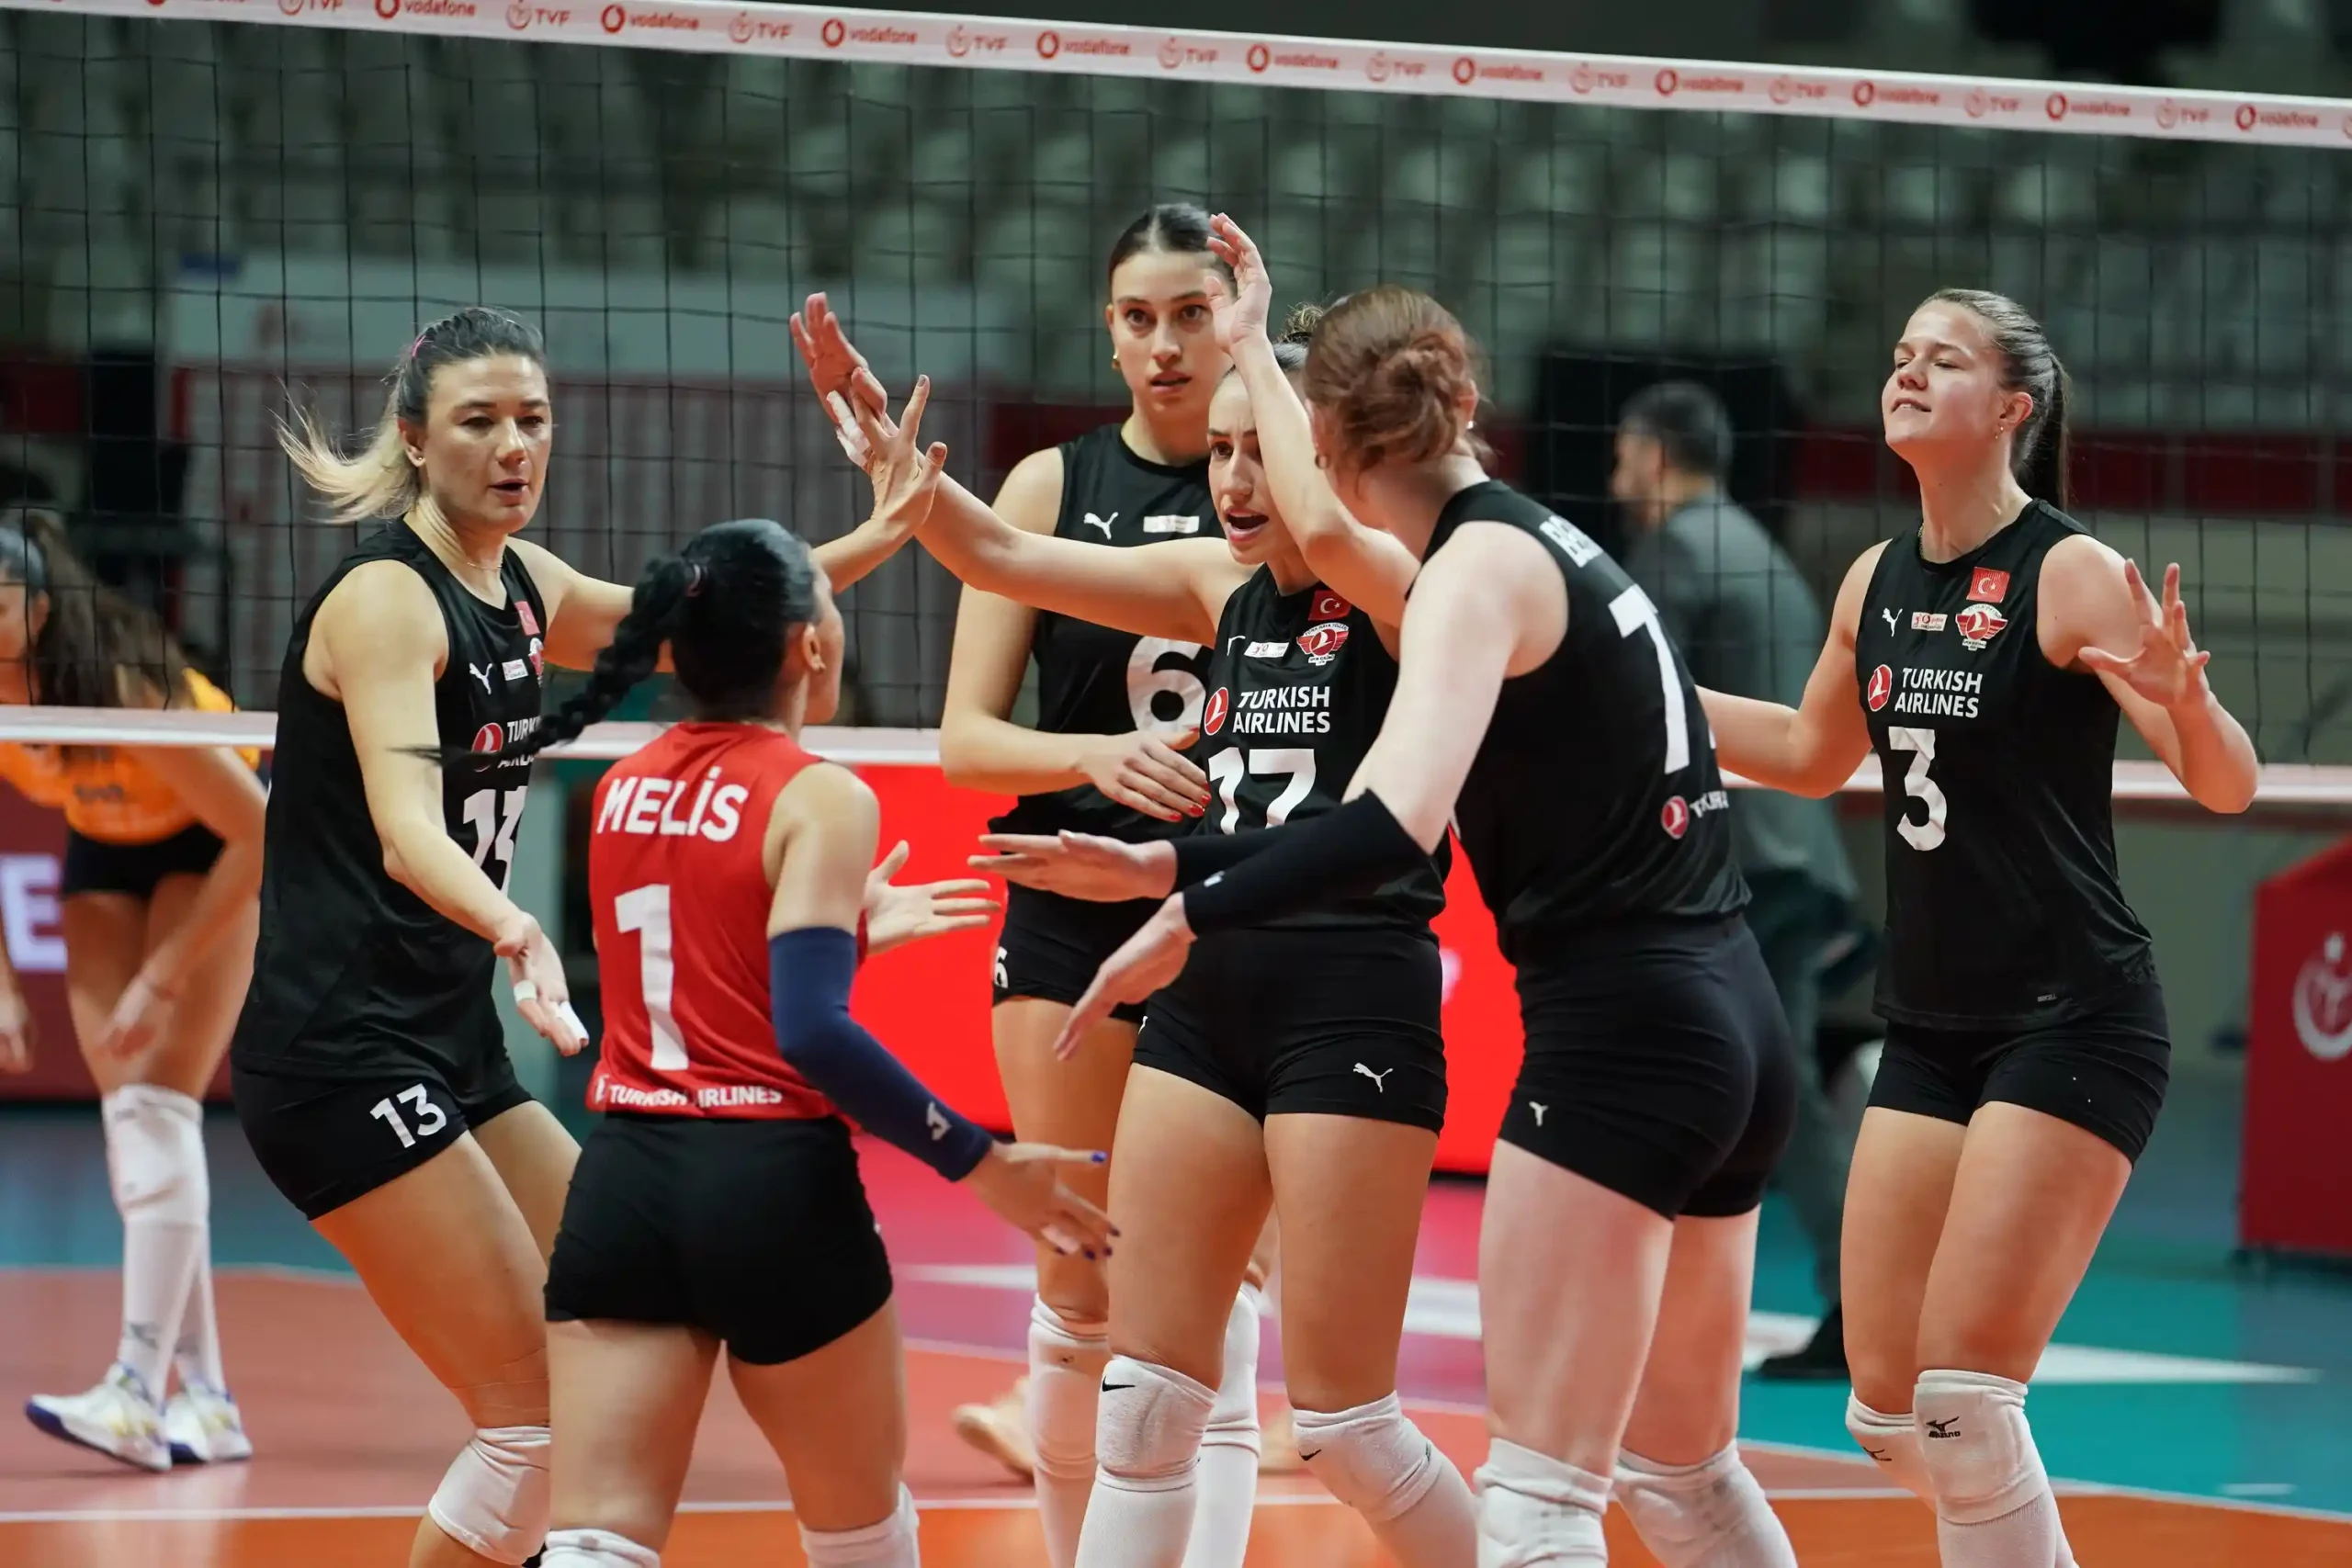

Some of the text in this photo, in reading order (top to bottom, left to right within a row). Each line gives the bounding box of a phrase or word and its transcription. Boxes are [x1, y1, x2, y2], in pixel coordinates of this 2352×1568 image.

[404, 1, 476, 17] vodafone
[533, 8, 571, 26] TVF
[630, 14, 700, 30] vodafone
[756, 22, 793, 39] TVF
[849, 28, 918, 44] vodafone
[973, 35, 1007, 51] TVF
[1126, 636, 1206, 750] 6
[1238, 685, 1330, 710] TURKISH
[1894, 692, 1980, 719] AIRLINES
[1902, 667, 1984, 694] TURKISH
[507, 716, 541, 743] TURK
[1232, 710, 1331, 735] AIRLINES
[596, 765, 750, 842] MELİS
[1207, 746, 1317, 835] 17
[1888, 726, 1948, 852] 3
[0, 853, 68, 971] E
[615, 883, 689, 1071] 1
[369, 1083, 447, 1148] 13
[608, 1082, 783, 1108] TURKISH IRLINES
